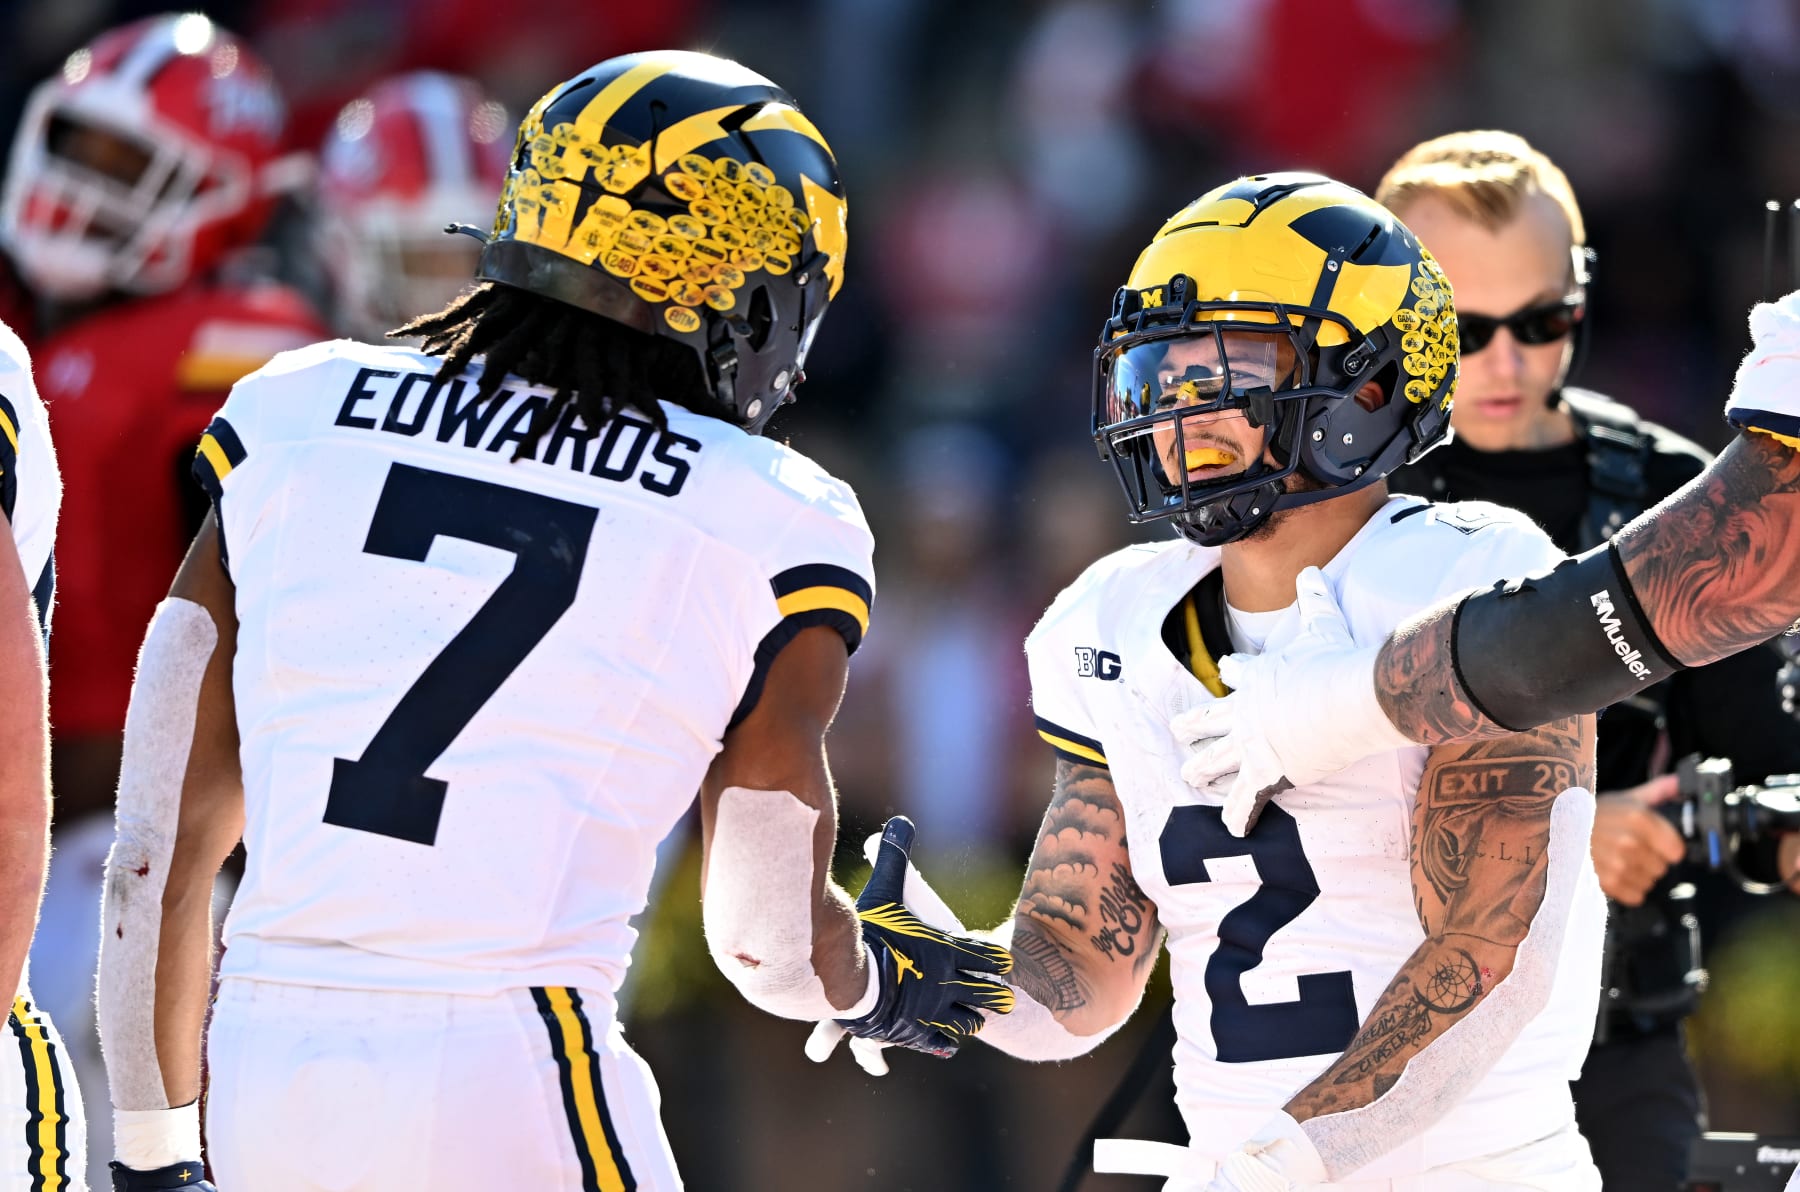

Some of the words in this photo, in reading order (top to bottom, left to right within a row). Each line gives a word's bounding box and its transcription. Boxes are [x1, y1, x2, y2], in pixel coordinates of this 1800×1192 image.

[1141, 288, 1163, 309] M
[334, 367, 703, 498] EDWARDS
[322, 461, 600, 847] 7
[1440, 768, 1510, 796] EXIT
[1532, 763, 1570, 796] 28
[1158, 800, 1360, 1063] 2
